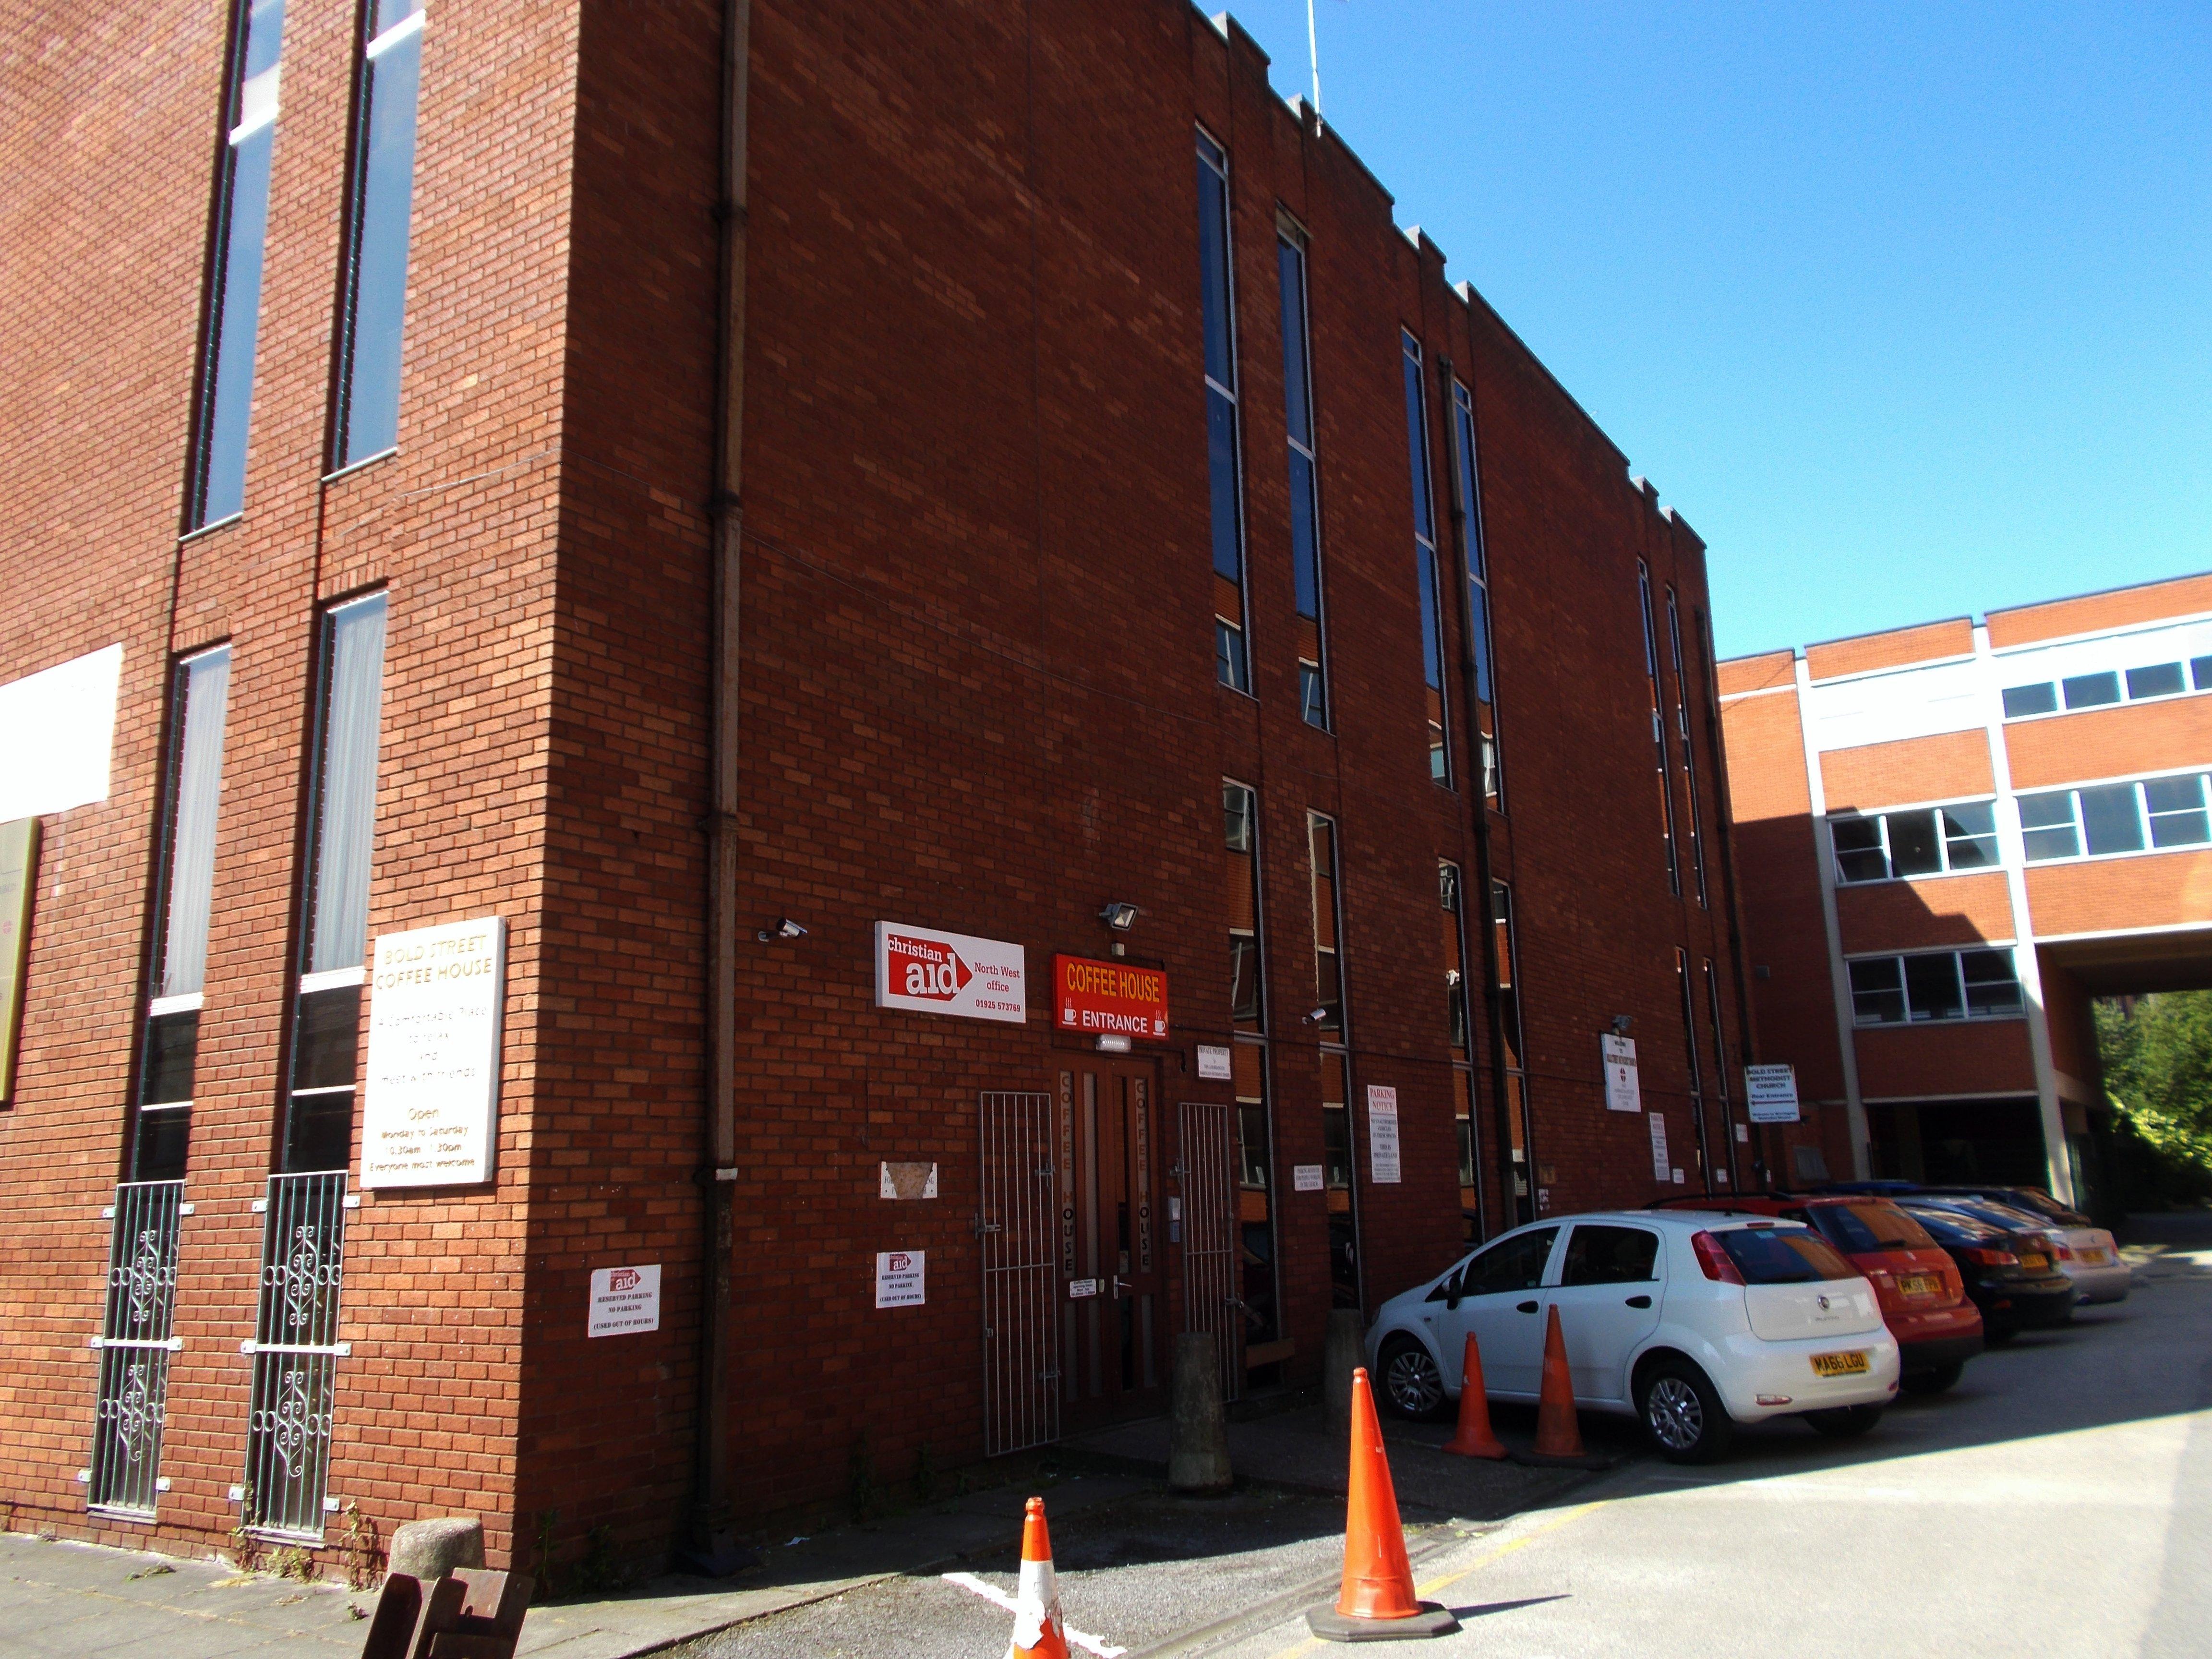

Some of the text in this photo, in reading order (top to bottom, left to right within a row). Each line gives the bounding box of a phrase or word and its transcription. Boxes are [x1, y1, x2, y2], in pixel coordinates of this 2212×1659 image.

[385, 935, 487, 965] BOLD STREET
[888, 937, 942, 962] christian
[376, 957, 493, 989] COFFEE HOUSE
[906, 953, 961, 995] aid
[974, 962, 1021, 978] North West
[986, 980, 1010, 992] office
[1067, 963, 1160, 1003] COFFEE HOUSE
[975, 999, 1021, 1012] 01925 573769
[1082, 1010, 1148, 1034] ENTRANCE
[1370, 1087, 1394, 1099] PARKING
[1372, 1101, 1393, 1111] NOTICE
[409, 1107, 439, 1124] Open
[1060, 1075, 1071, 1170] COFFEE
[1136, 1082, 1146, 1171] COFFEE
[381, 1130, 415, 1140] Monday
[369, 1163, 409, 1174] Everyone
[436, 1158, 475, 1168] welcome
[1062, 1190, 1074, 1272] HOUSE
[893, 1255, 908, 1270] aid
[616, 1272, 636, 1290] aid
[598, 1292, 652, 1303] RESERVED PARKING
[617, 1304, 642, 1312] PARKING
[593, 1322, 612, 1330] (USED
